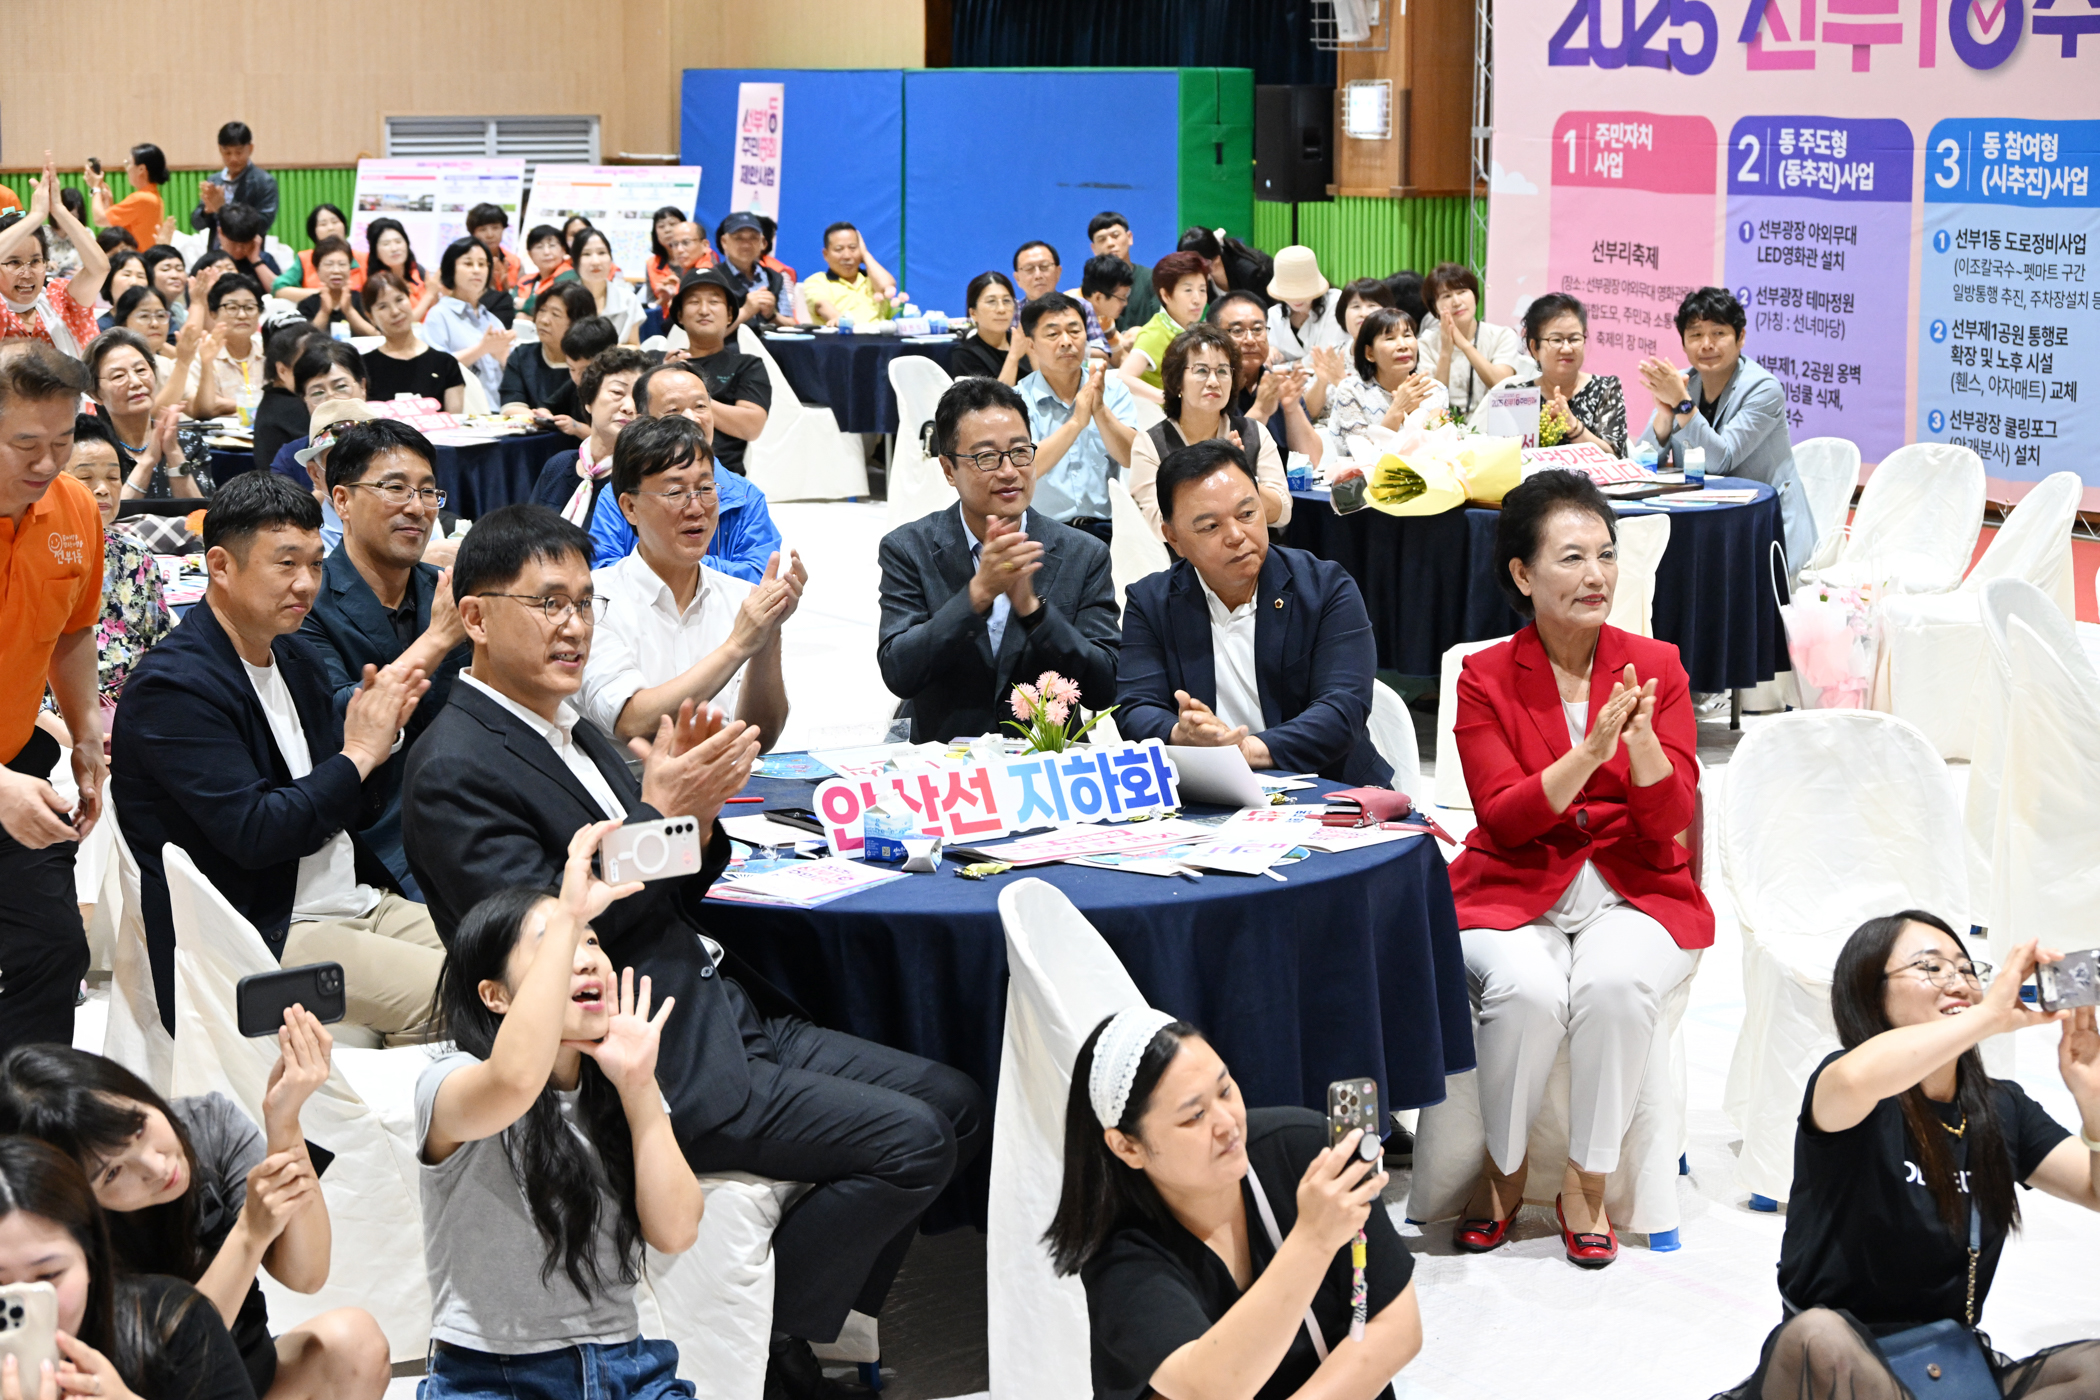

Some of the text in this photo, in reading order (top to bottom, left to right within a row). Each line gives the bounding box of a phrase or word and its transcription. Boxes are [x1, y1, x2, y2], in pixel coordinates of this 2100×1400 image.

[1595, 122, 1652, 151] 주민자치
[1779, 128, 1847, 158] 동 주도형
[1982, 131, 2059, 162] 동 참여형
[1563, 129, 1576, 173] 1
[1594, 151, 1623, 178] 사업
[1737, 134, 1760, 182] 2
[1934, 138, 1960, 188] 3
[1778, 158, 1874, 194] (동추진)사업
[1981, 163, 2088, 200] (시추진)사업
[1758, 220, 1806, 241] 선부광장
[1808, 223, 1857, 246] 야외무대
[1955, 228, 2002, 251] 선부1동
[2004, 232, 2087, 255] 도로정비사업
[1592, 240, 1659, 270] 선부리축제
[1758, 246, 1845, 271] LED영화관 설치
[2061, 263, 2086, 282] 구간
[1622, 281, 1656, 301] 야외무대
[1756, 286, 1803, 308] 선부광장
[1806, 290, 1855, 314] 테마정원
[1953, 284, 1998, 304] 일방통행
[2001, 287, 2027, 310] 추진,
[2030, 290, 2088, 310] 주차장설치
[1623, 307, 1651, 328] 주민과
[1793, 313, 1846, 341] 선녀마당)
[1596, 331, 1657, 355] 축제의 장 마련
[1952, 318, 2024, 347] 선부제1공원
[2027, 325, 2069, 347] 통행로
[1802, 361, 1834, 384] 2공원
[1837, 363, 1861, 385] 옹벽
[1951, 344, 2053, 374] 확장 및 노후 시설
[1816, 388, 1843, 411] 식재,
[1988, 375, 2046, 403] 야자매트)
[2050, 381, 2078, 402] 교체
[1949, 409, 2001, 435] 선부광장
[2004, 416, 2058, 439] 쿨링포그
[2014, 444, 2040, 466] 설치
[1007, 746, 1174, 824] 지하화
